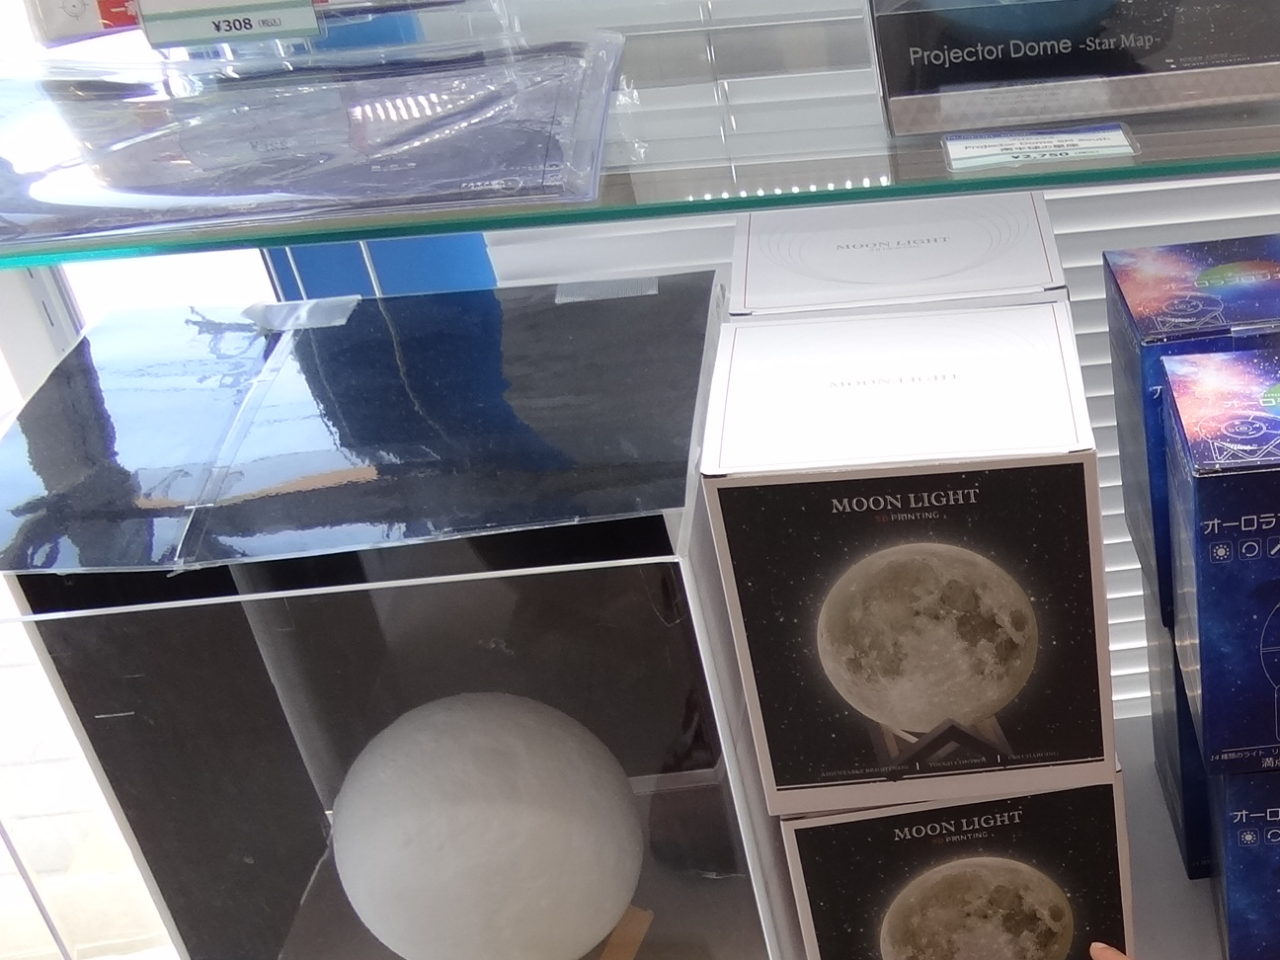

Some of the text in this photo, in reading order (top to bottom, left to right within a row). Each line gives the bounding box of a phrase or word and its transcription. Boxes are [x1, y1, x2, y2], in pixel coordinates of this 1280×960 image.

[212, 18, 253, 33] ¥308
[909, 43, 1003, 67] Projector
[1010, 37, 1073, 58] Dome
[1078, 35, 1117, 52] -Star
[1011, 151, 1070, 160] ¥2,750
[832, 488, 980, 513] MOON LIGHT
[894, 810, 1022, 840] MOON LIGHT
